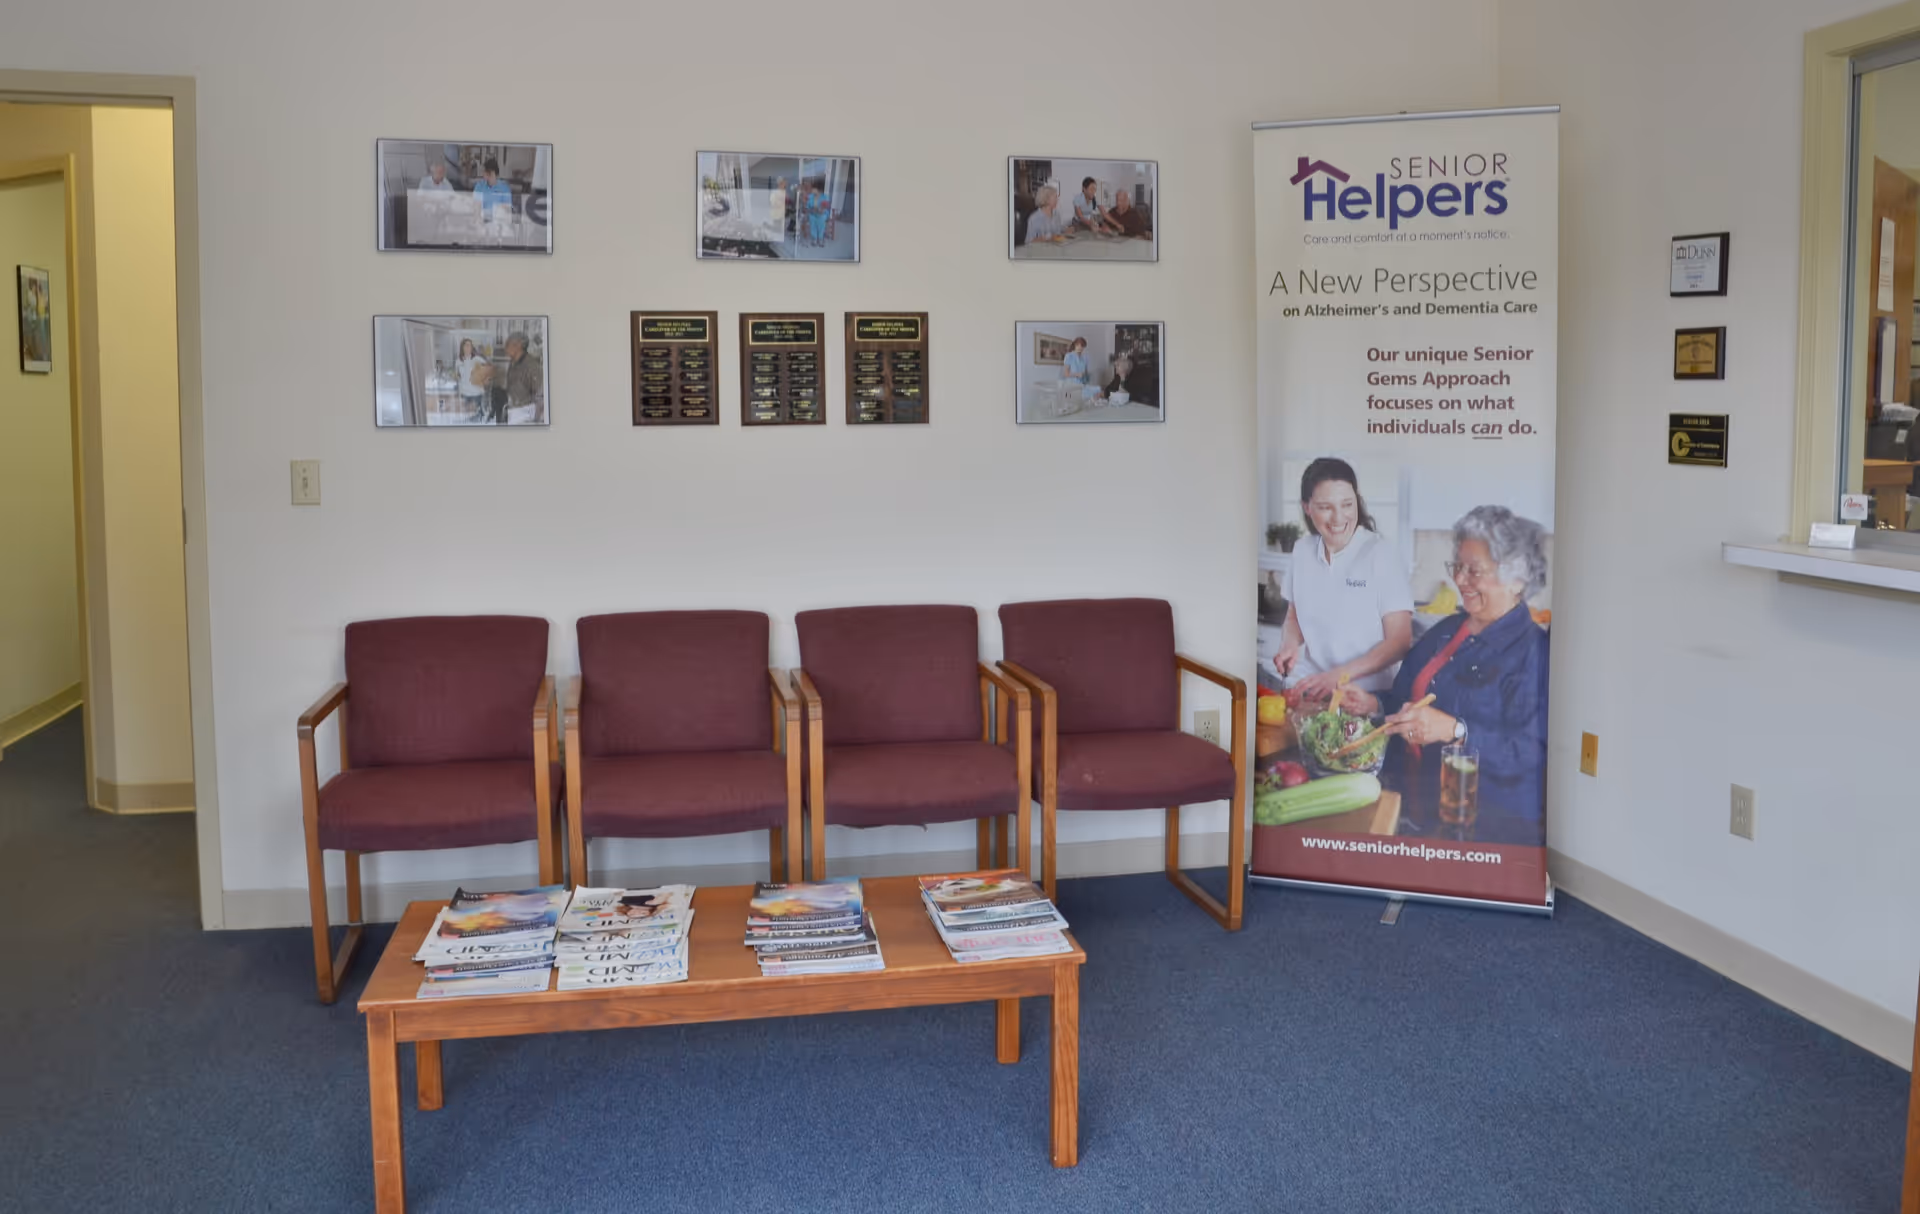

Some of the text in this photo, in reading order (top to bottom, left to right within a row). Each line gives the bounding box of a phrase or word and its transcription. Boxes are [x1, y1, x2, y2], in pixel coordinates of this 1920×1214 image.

[1389, 153, 1508, 179] SENIOR
[1304, 173, 1508, 230] Helpers
[1303, 234, 1329, 245] Care
[1331, 234, 1352, 244] and
[1354, 232, 1393, 243] comfort
[1396, 232, 1406, 241] at
[1419, 230, 1471, 241] moment's
[1269, 264, 1538, 298] A New Perspective
[1283, 301, 1538, 317] on Alzheimer's and Dementia Care
[1367, 345, 1534, 365] Our unique Senior
[1367, 369, 1511, 389] Gems Approach
[1367, 394, 1515, 410] focuses on what
[1367, 419, 1537, 435] individuals can do.
[1301, 836, 1502, 864] www.seniorhelpers.com
